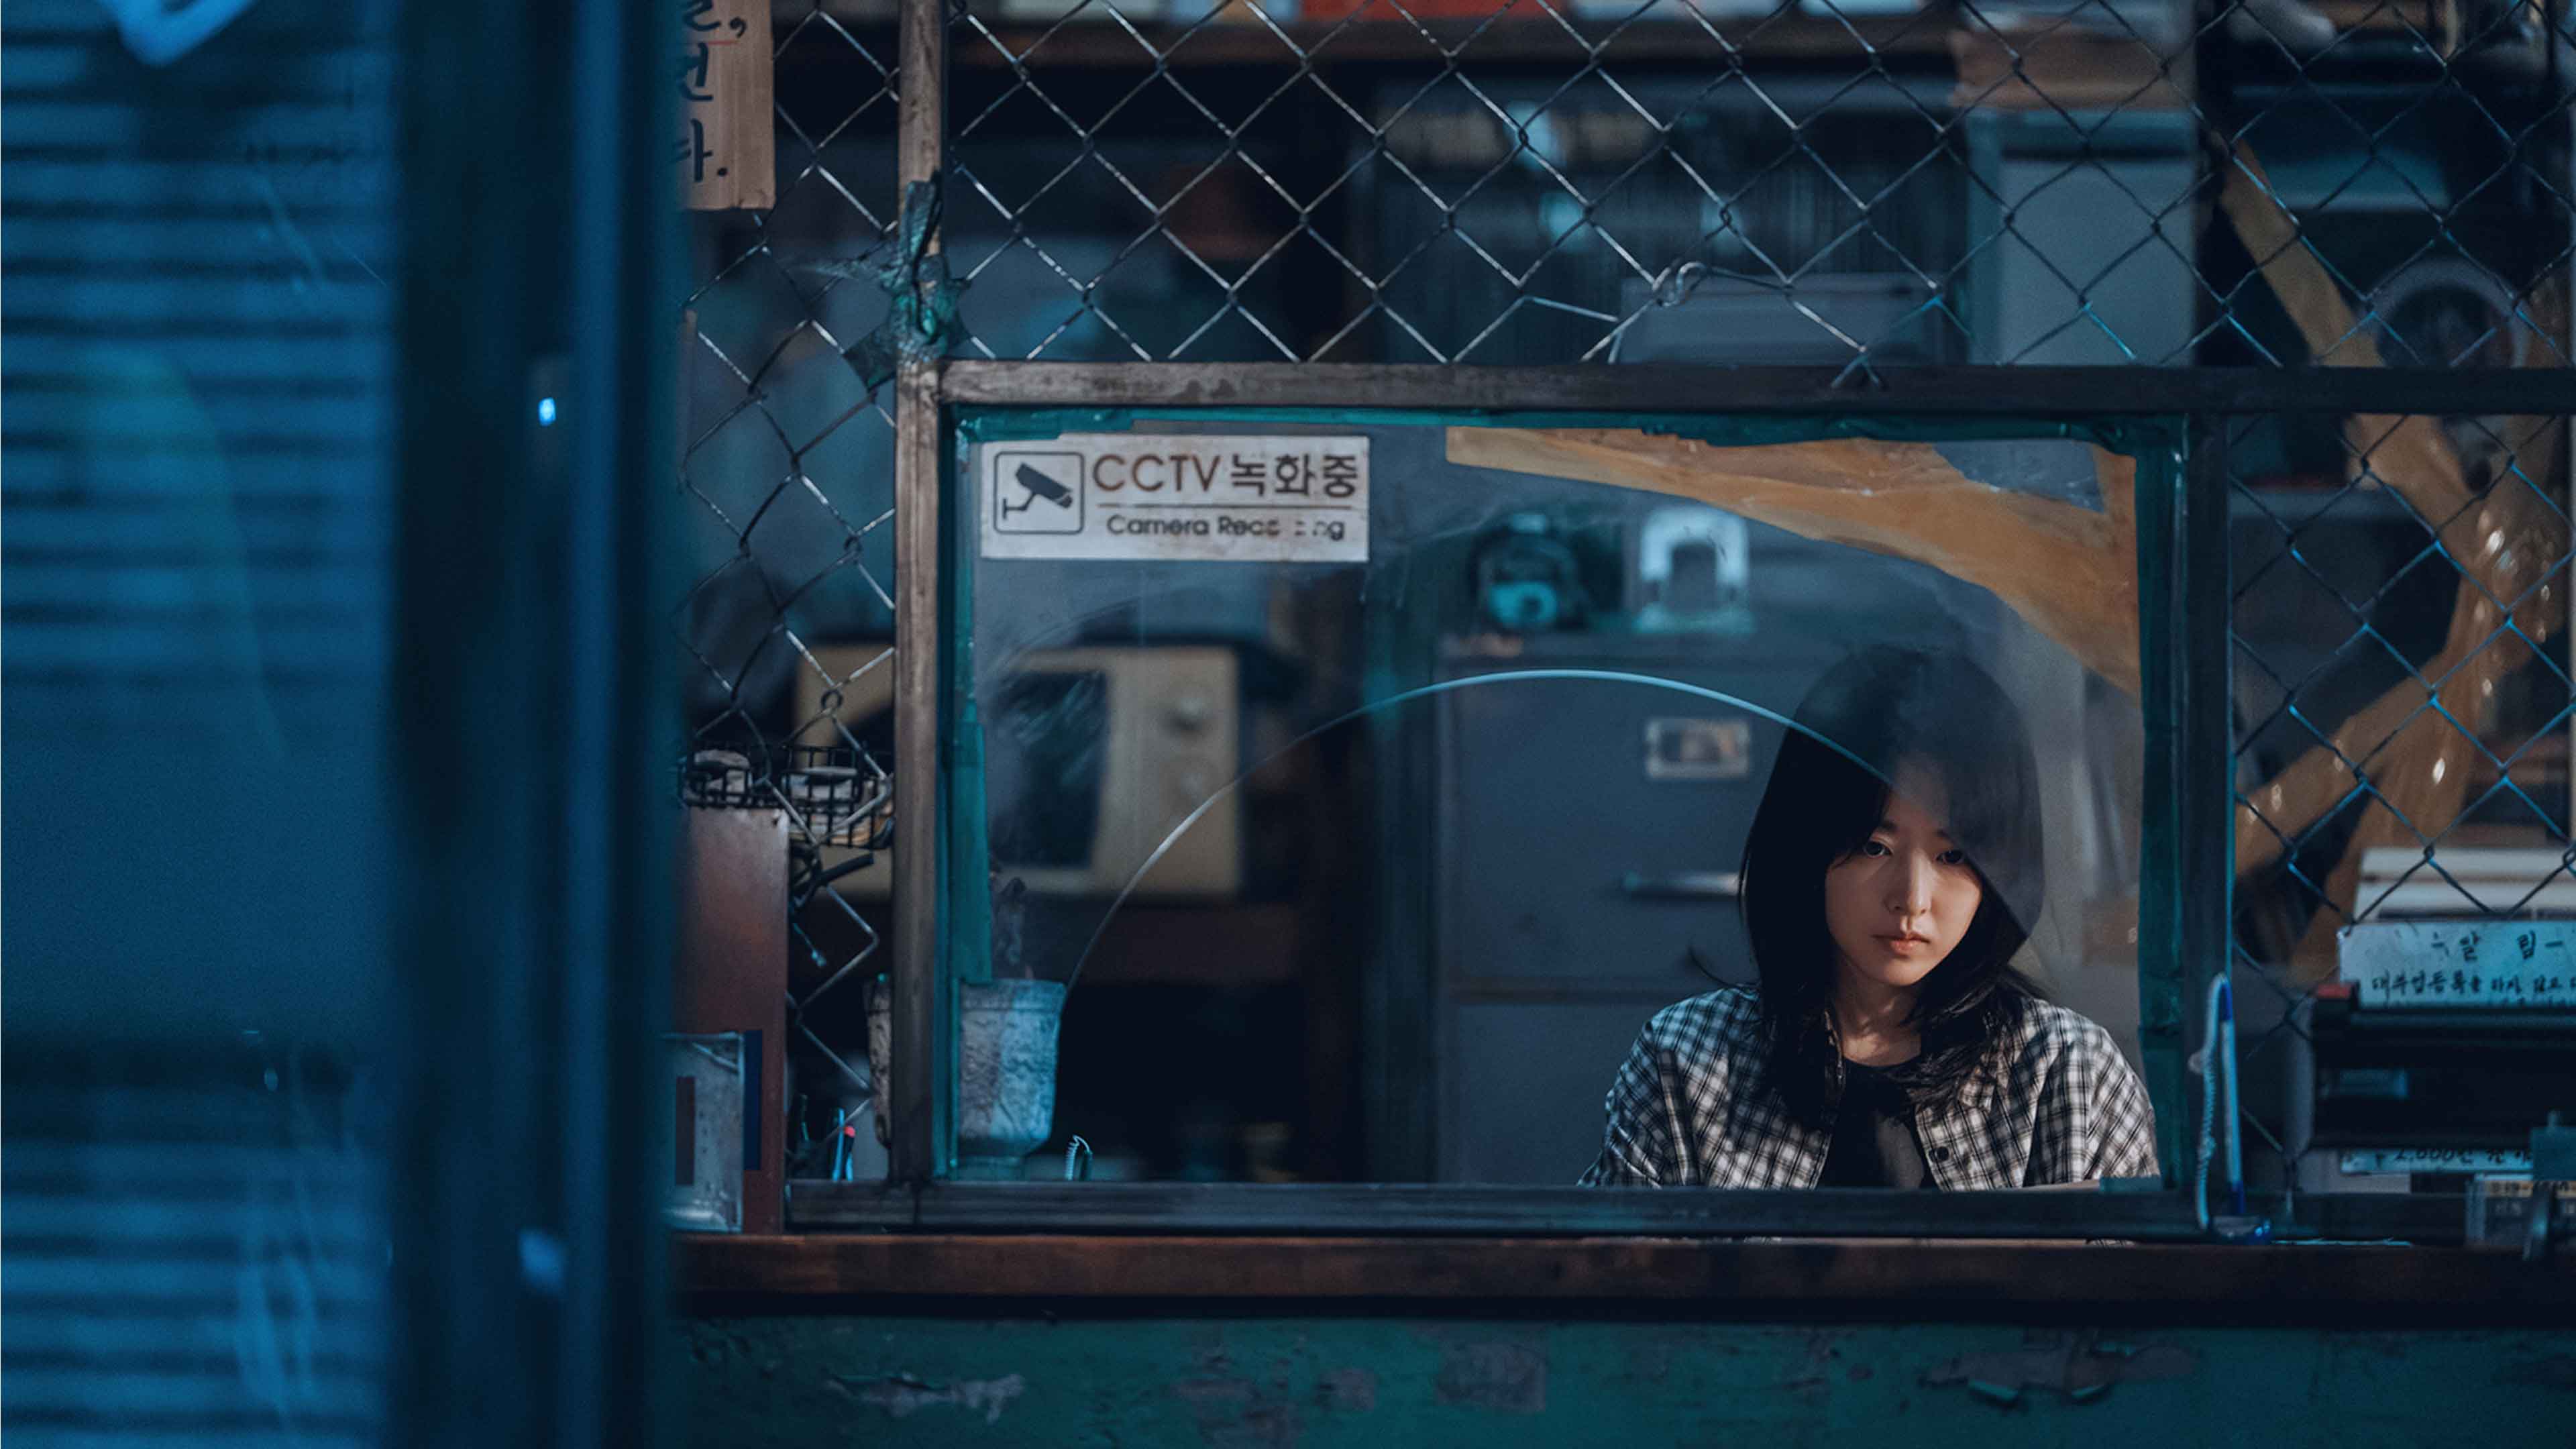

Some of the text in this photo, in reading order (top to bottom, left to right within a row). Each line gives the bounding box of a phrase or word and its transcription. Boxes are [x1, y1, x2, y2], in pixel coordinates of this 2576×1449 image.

[1092, 453, 1358, 497] CCTV 녹화중
[1107, 515, 1210, 536] Camera
